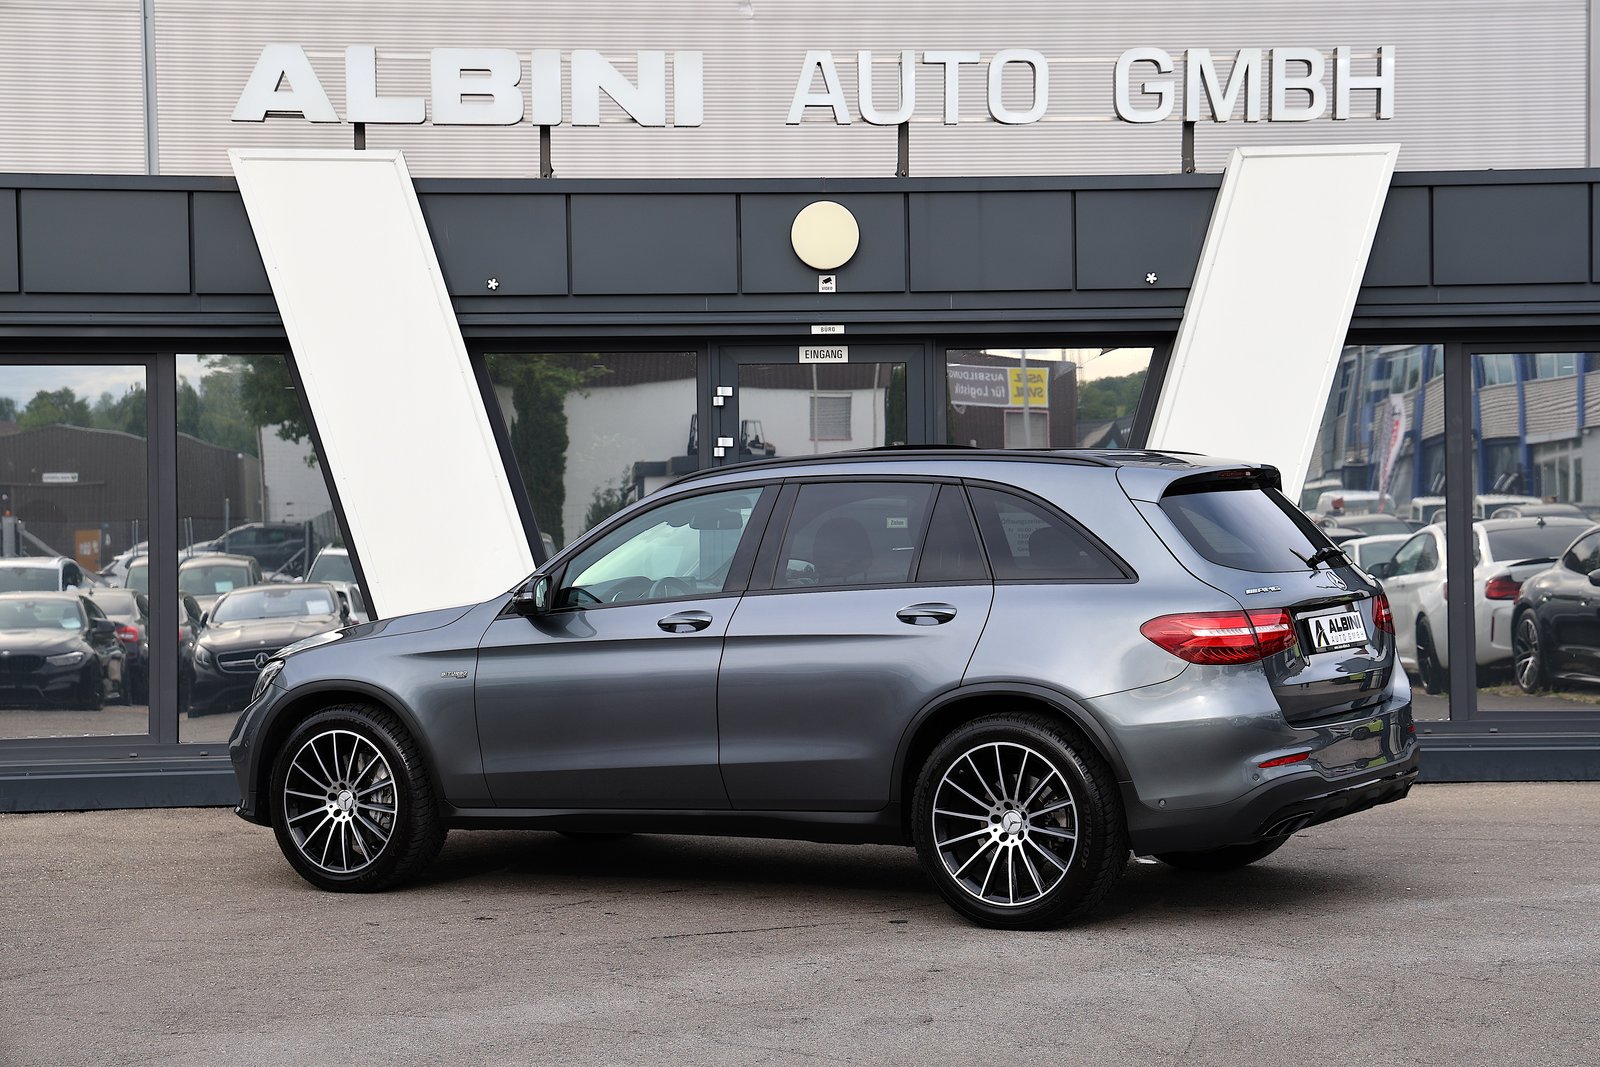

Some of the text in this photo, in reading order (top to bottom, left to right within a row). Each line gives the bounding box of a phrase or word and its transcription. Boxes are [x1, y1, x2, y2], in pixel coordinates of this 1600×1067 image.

[231, 44, 1395, 127] ALBINI AUTO GMBH
[804, 349, 843, 359] EINGANG
[1329, 615, 1361, 633] ALBINI
[1331, 633, 1347, 643] AUTO
